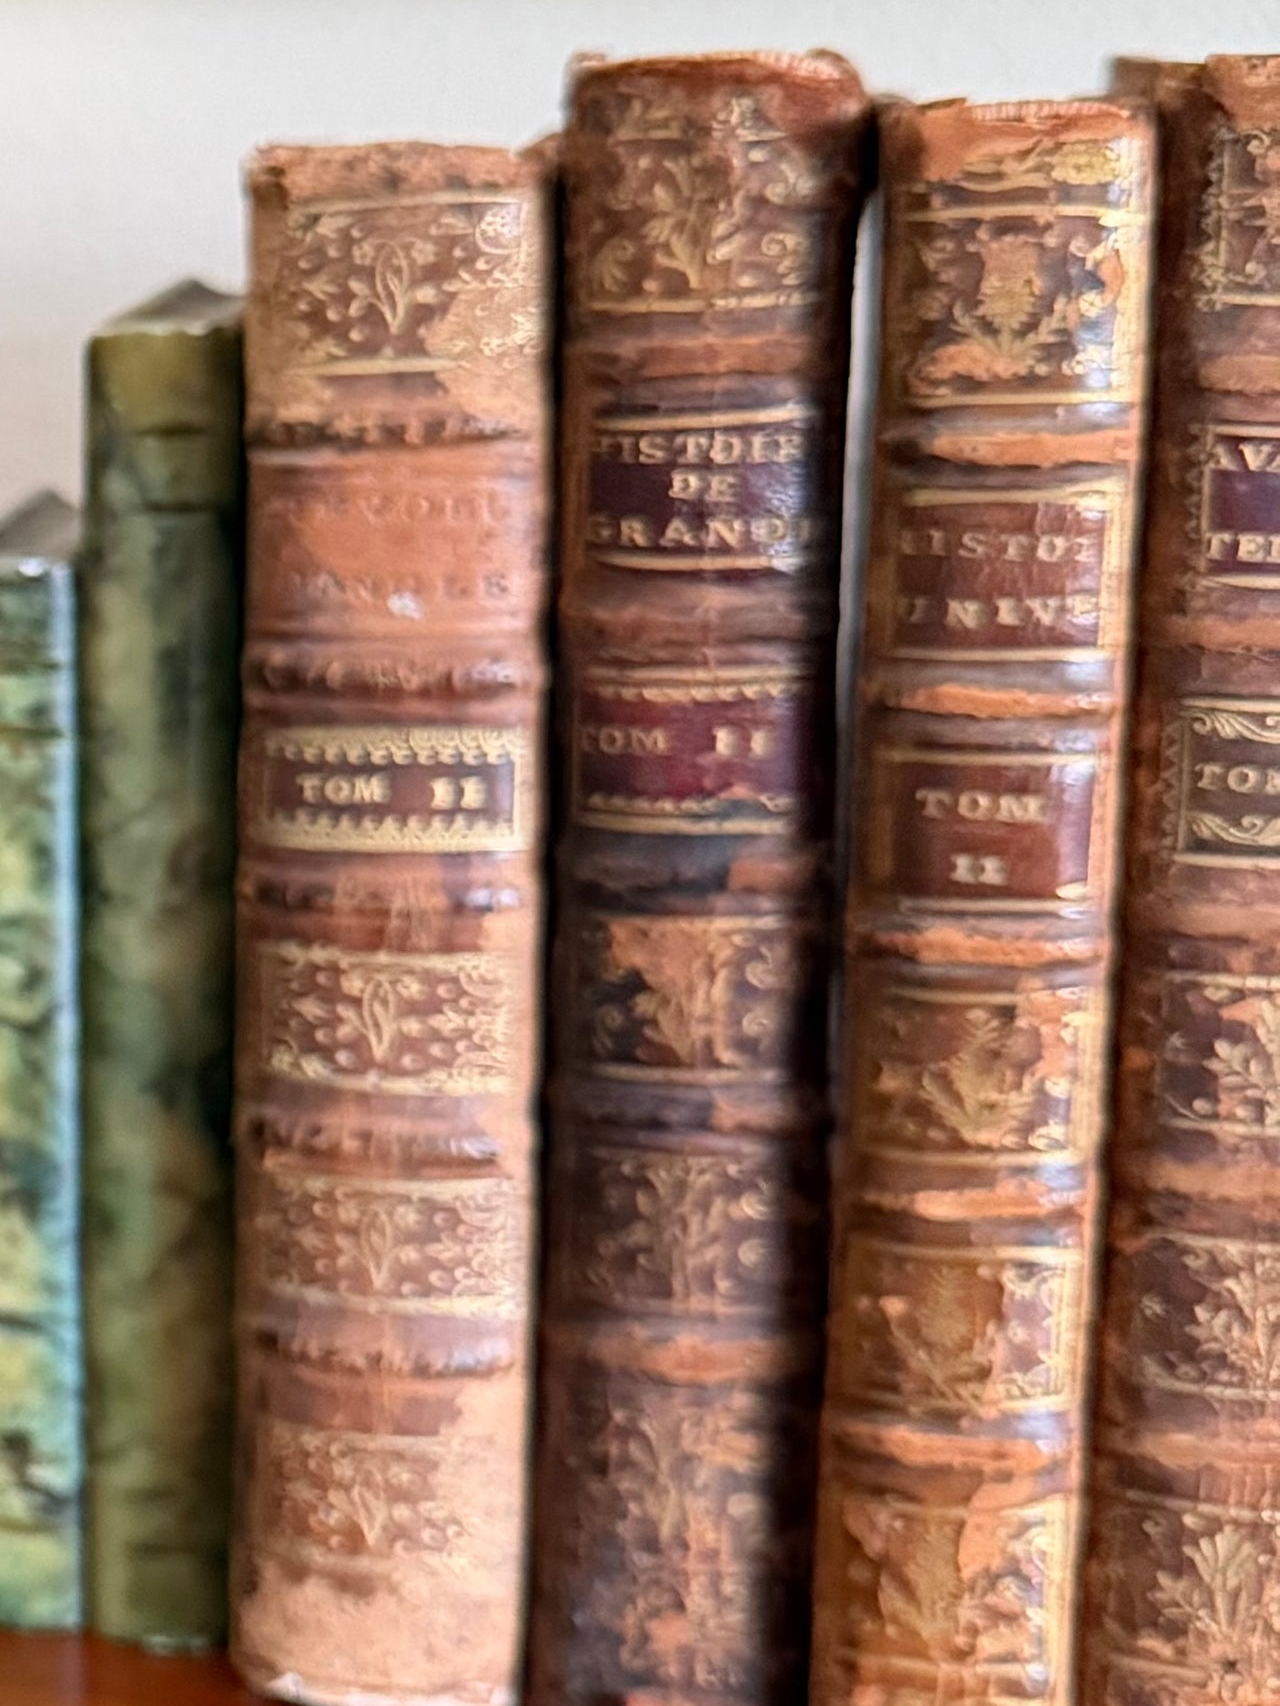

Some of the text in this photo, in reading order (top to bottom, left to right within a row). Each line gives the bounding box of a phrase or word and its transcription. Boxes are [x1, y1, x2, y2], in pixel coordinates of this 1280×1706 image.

[668, 467, 740, 501] DE
[295, 770, 391, 805] TOM
[914, 787, 1052, 824] TOM
